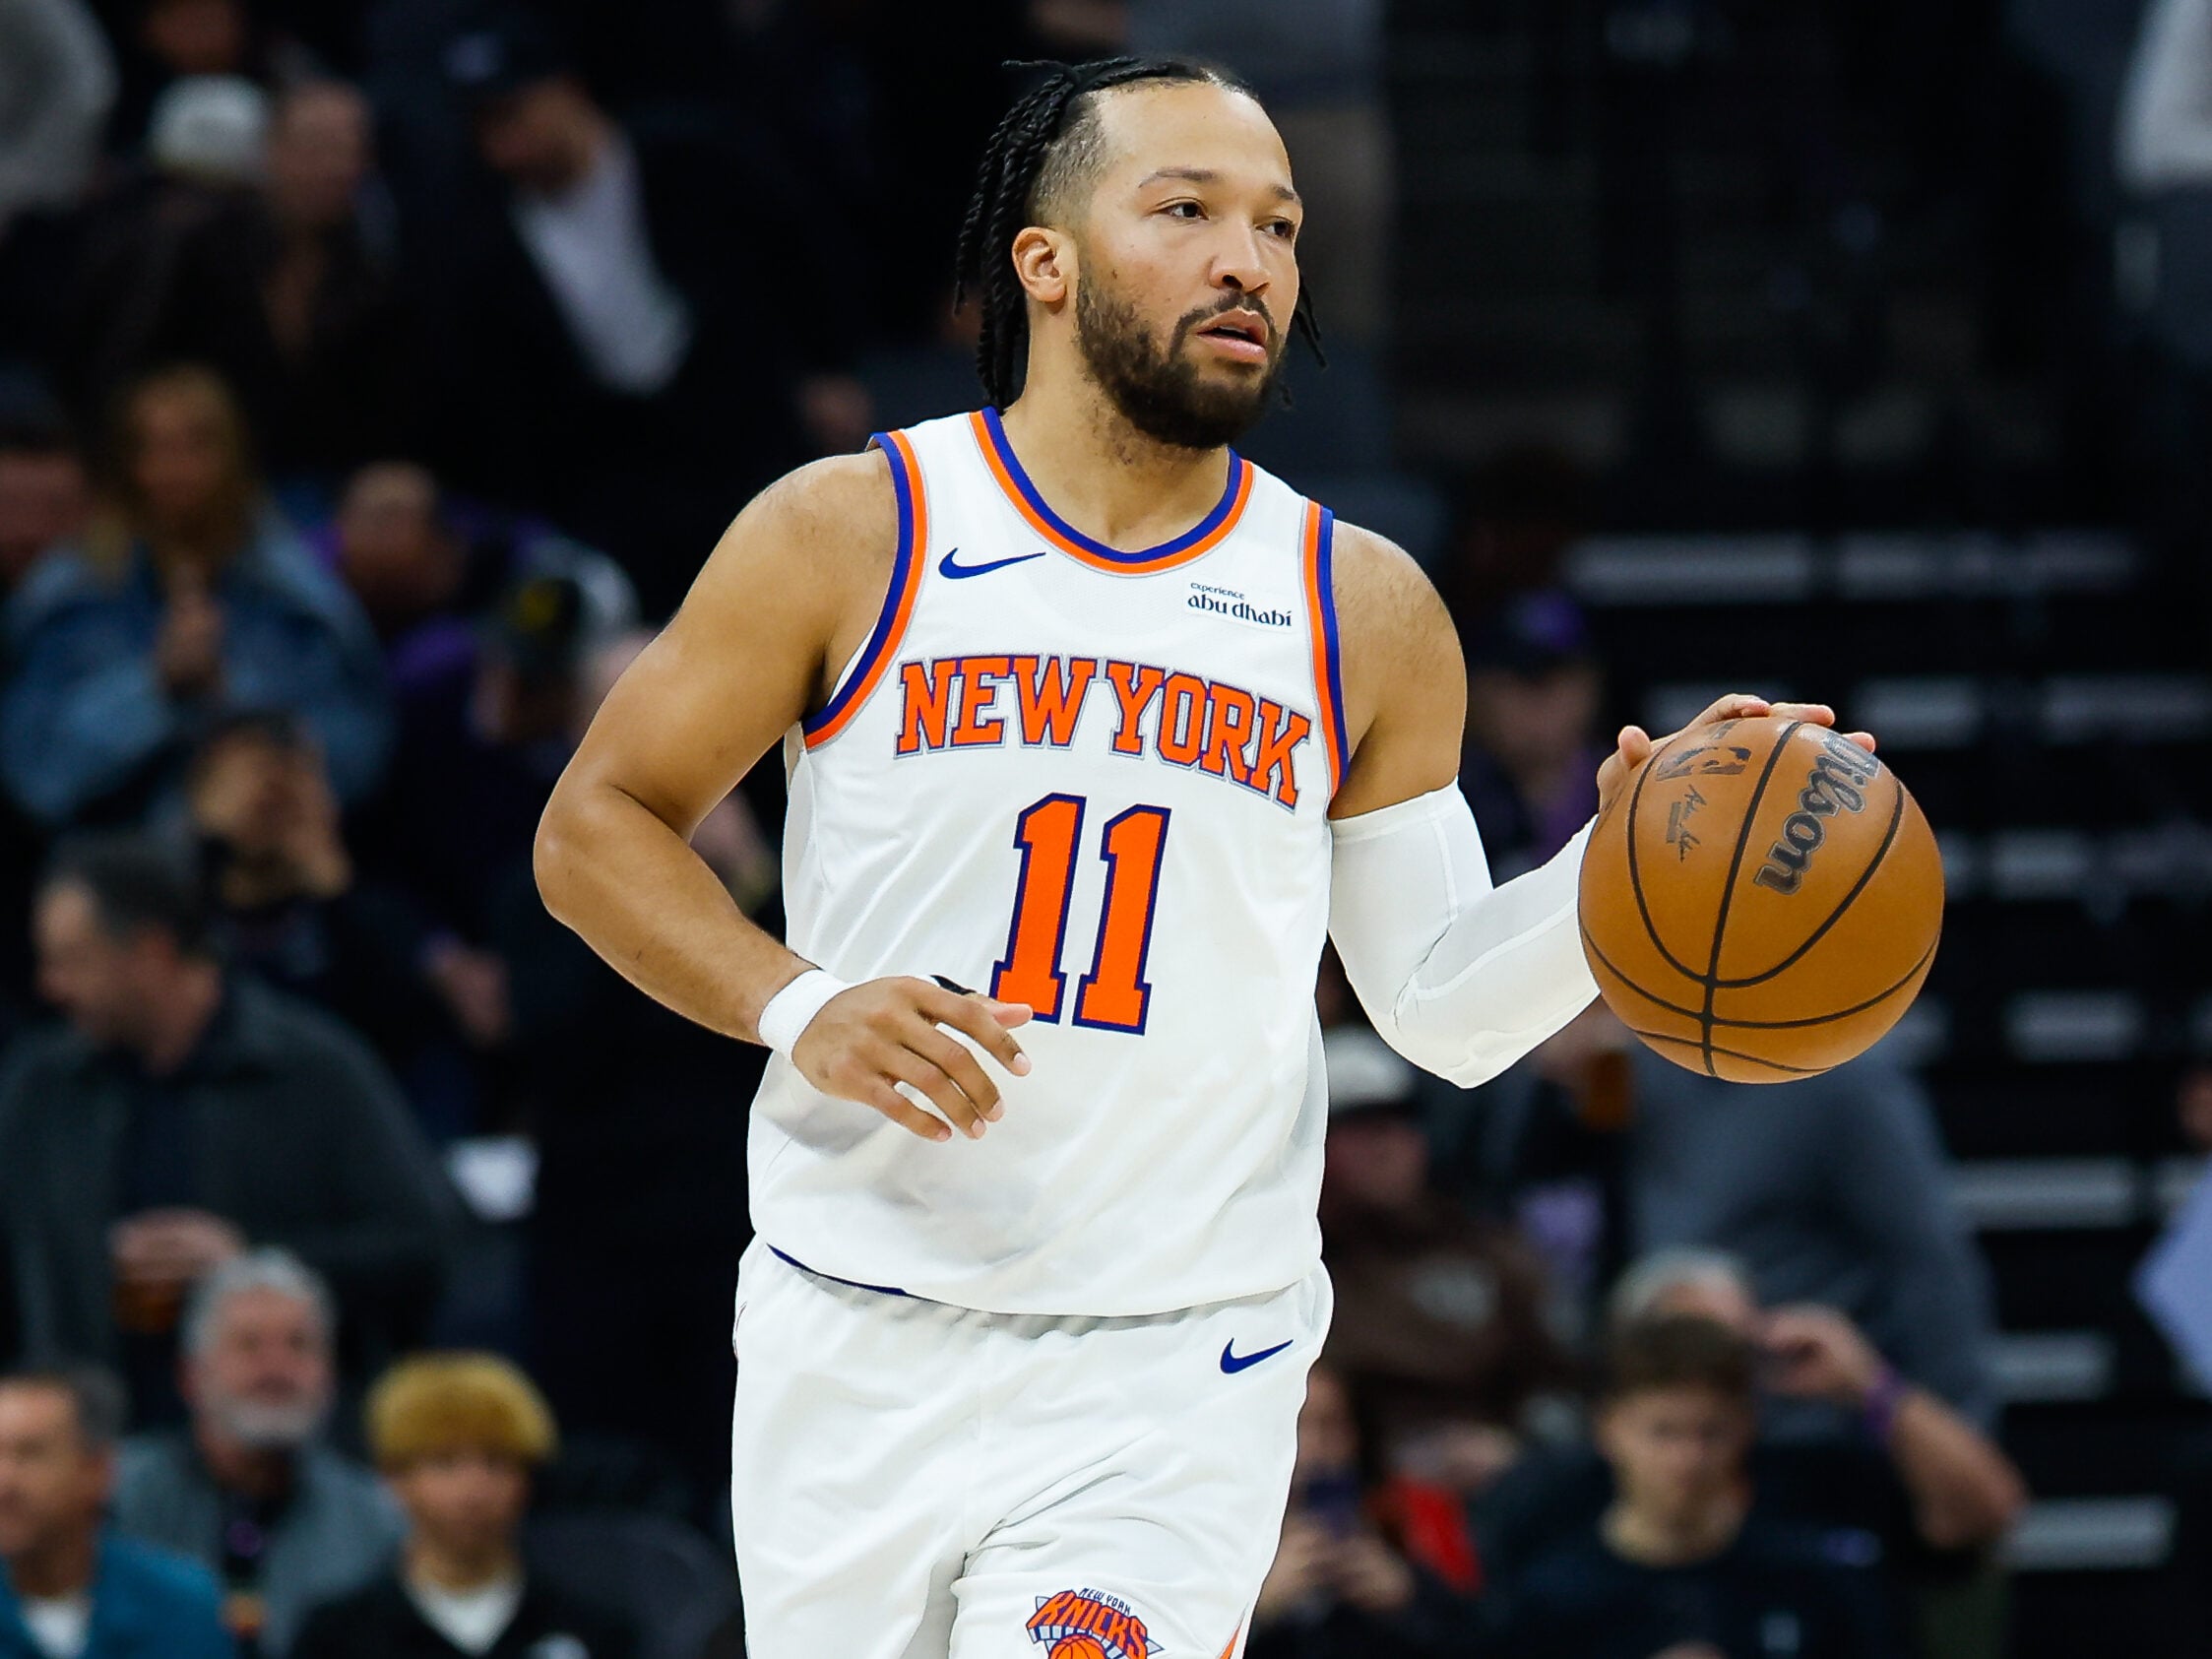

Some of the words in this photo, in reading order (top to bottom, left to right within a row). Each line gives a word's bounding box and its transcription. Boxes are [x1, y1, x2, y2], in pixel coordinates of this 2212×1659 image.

[1187, 594, 1228, 614] abu
[1232, 603, 1293, 627] dhabi
[1190, 582, 1245, 600] experience
[895, 654, 1096, 757] NEW
[1106, 663, 1311, 811] YORK
[988, 792, 1172, 1036] 11
[1026, 1589, 1149, 1659] KNICKS
[1077, 1587, 1106, 1602] NEW
[1106, 1593, 1133, 1616] YORK
